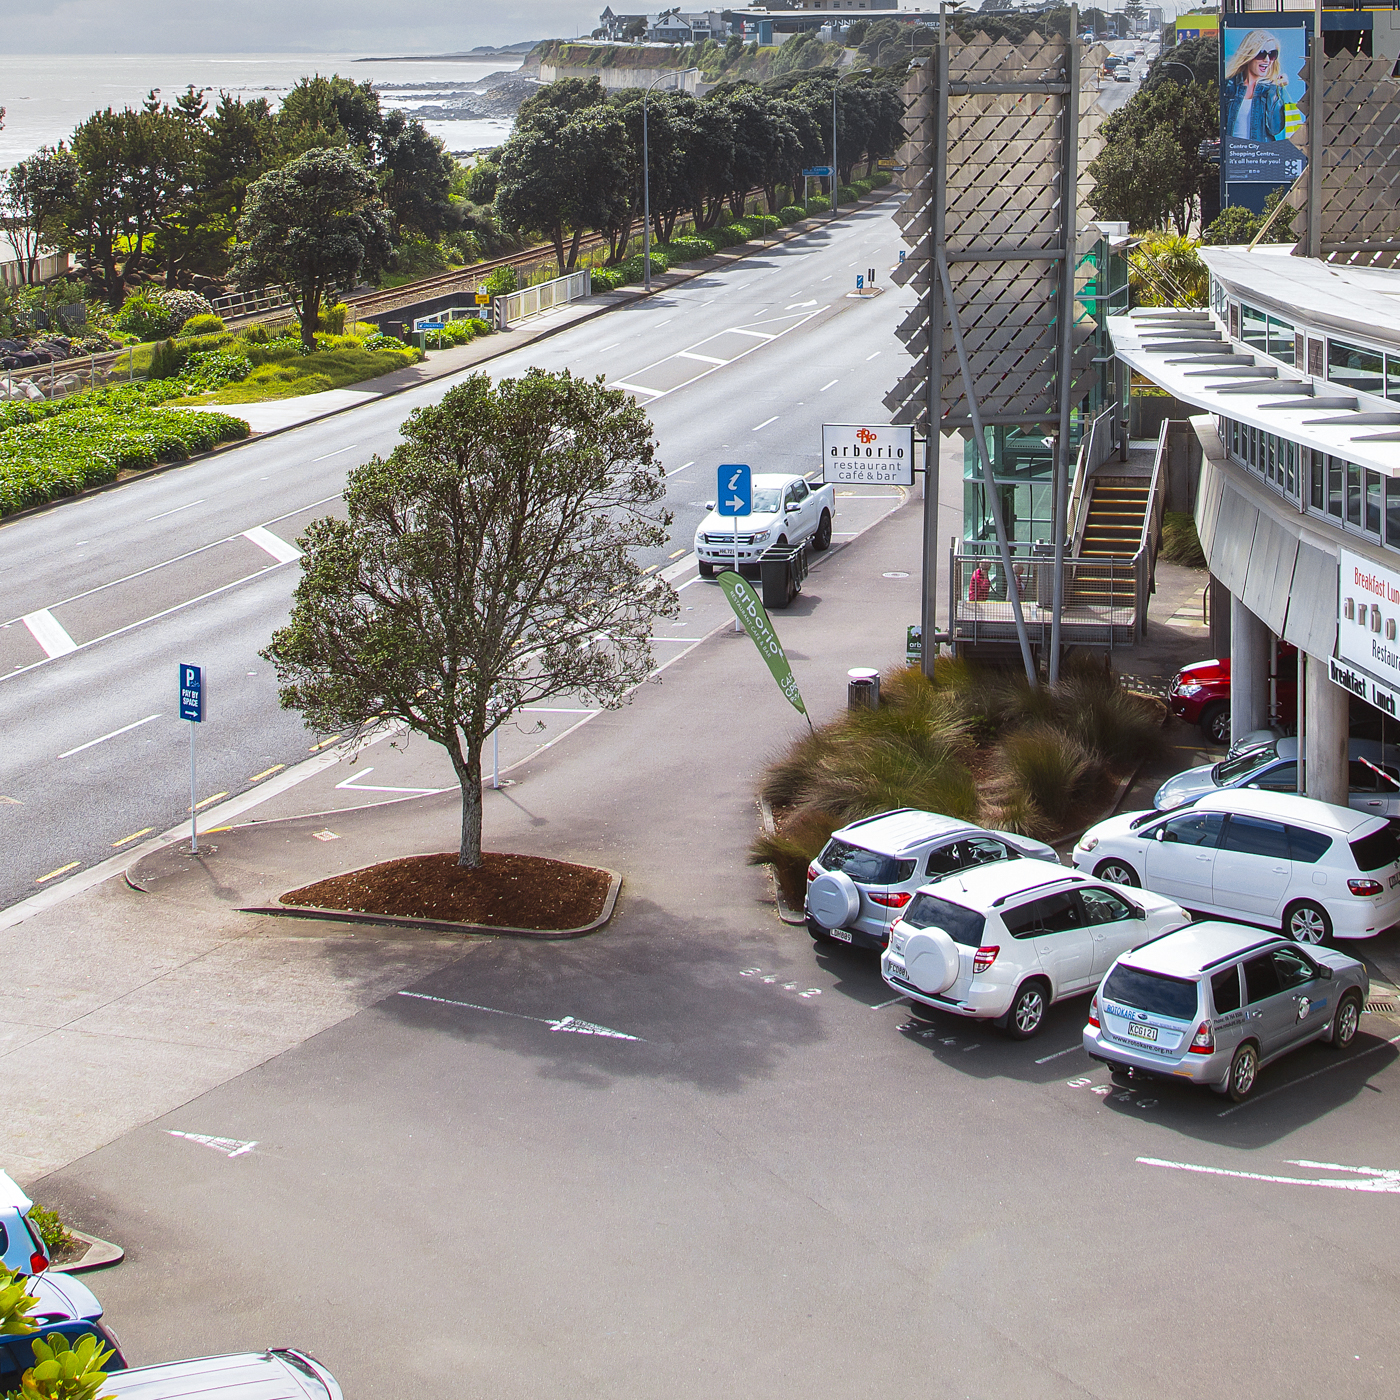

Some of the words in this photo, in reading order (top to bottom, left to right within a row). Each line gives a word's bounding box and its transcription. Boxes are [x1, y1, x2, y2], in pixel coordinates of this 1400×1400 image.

[831, 444, 904, 458] arborio
[833, 461, 901, 471] restaurant
[838, 470, 864, 480] café
[866, 471, 874, 480] &
[876, 471, 897, 481] bar
[1354, 567, 1386, 598] Breakfast
[730, 590, 753, 626] RESTAURANT
[762, 645, 772, 659] BAR
[734, 583, 779, 654] arborio
[186, 668, 195, 687] P
[182, 688, 191, 698] PAY
[191, 690, 199, 699] BY
[1330, 660, 1367, 700] Breakfast
[1372, 684, 1396, 716] Lunch
[182, 697, 199, 707] SPACE
[1106, 1004, 1136, 1020] ROTOKARE
[1129, 1024, 1156, 1039] KCG121
[1112, 1035, 1173, 1055] www.rotokare.org.nz
